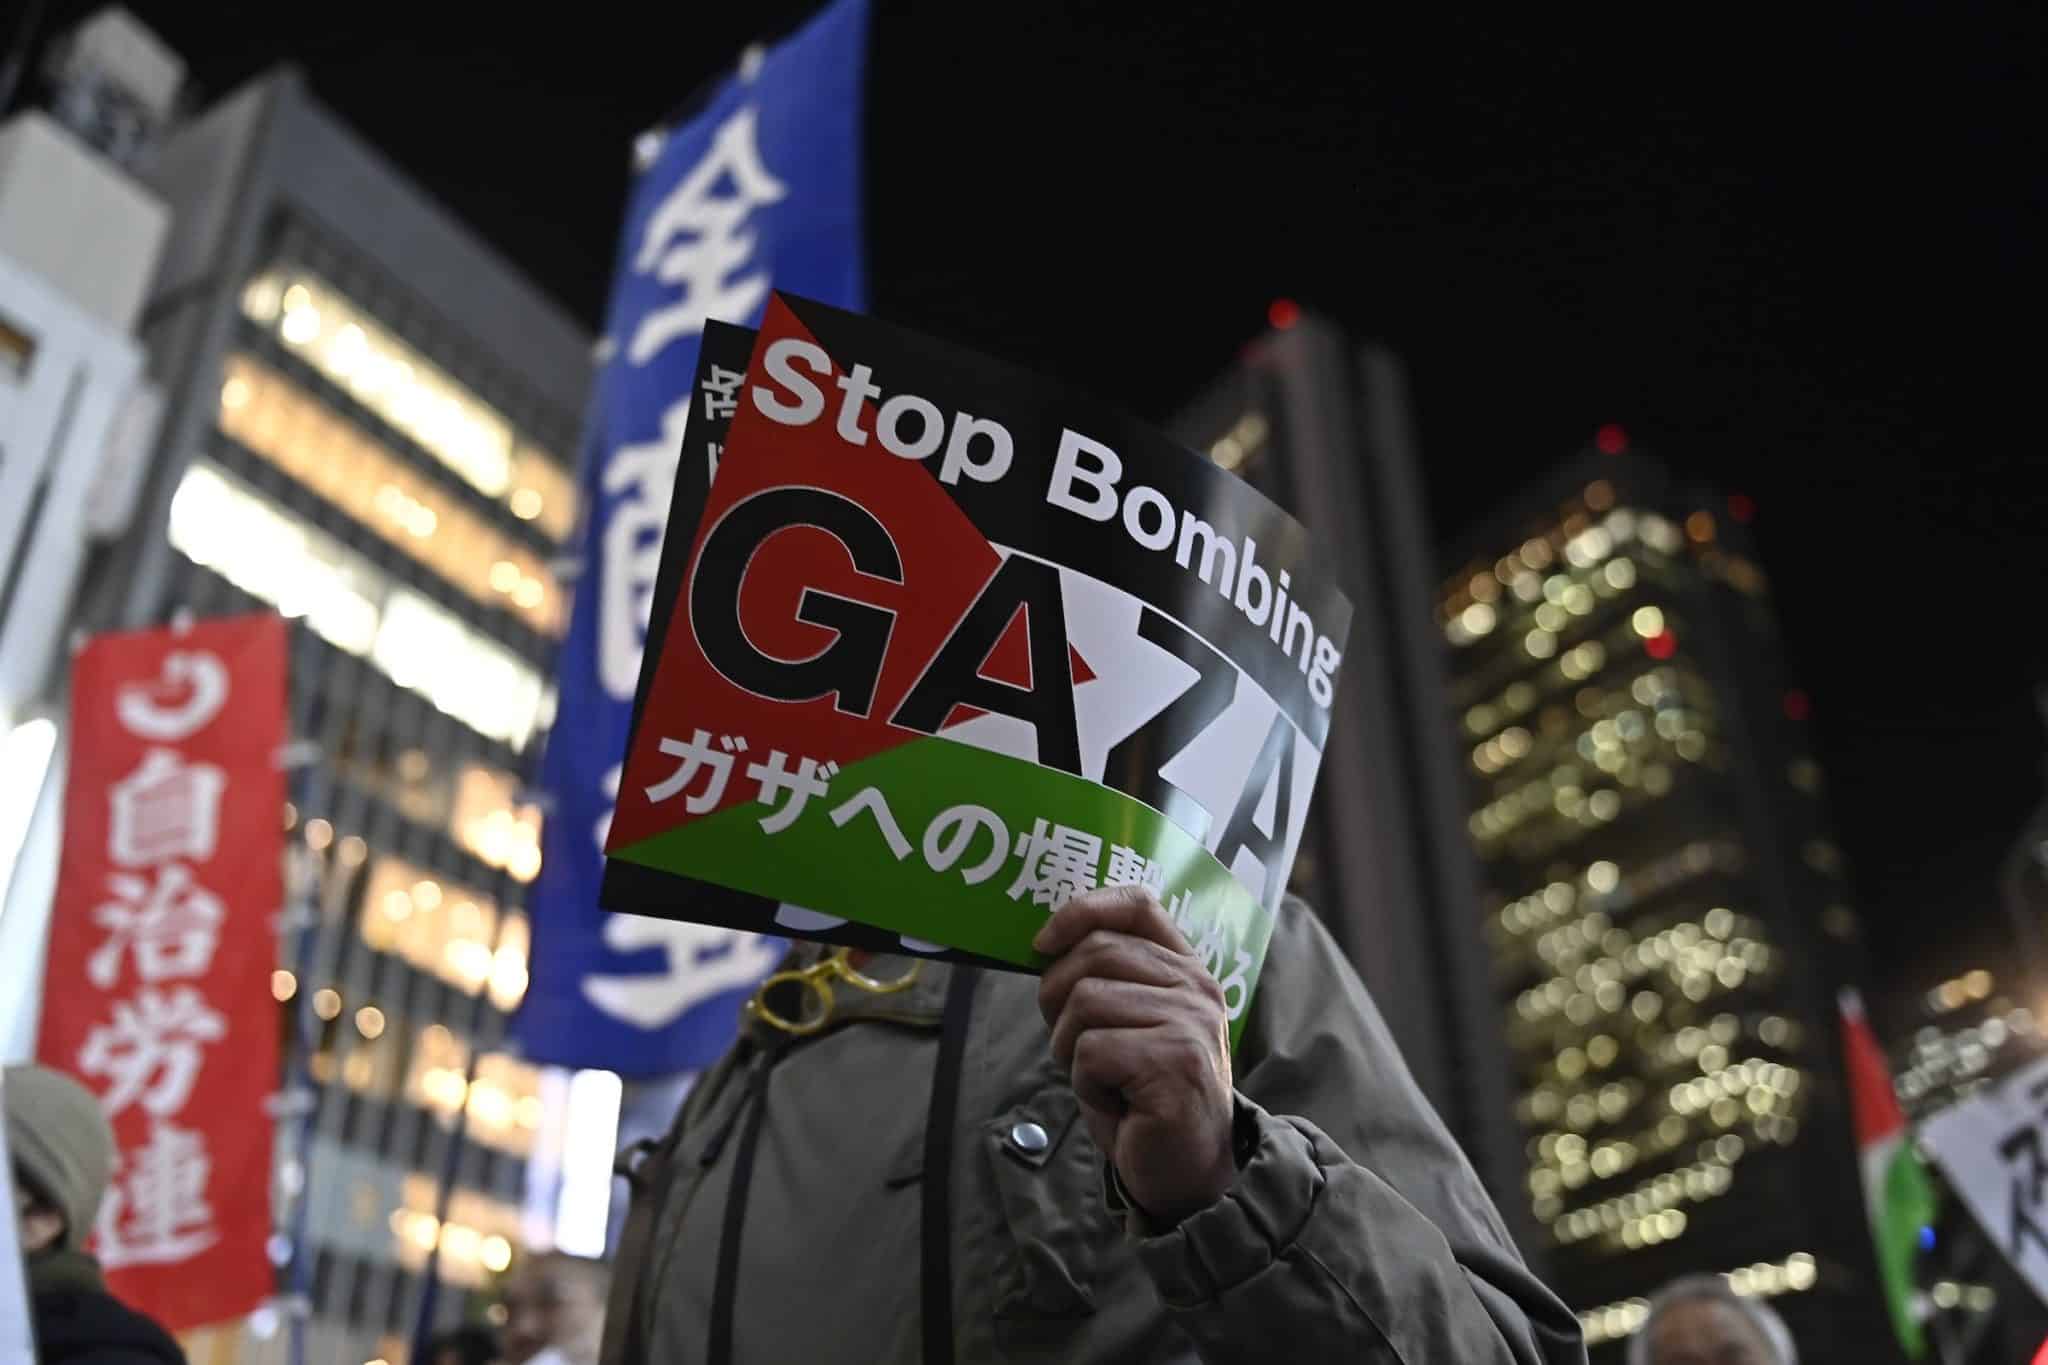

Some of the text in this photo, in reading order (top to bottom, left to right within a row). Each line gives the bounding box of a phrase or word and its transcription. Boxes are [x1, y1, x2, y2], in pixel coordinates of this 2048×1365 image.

[688, 485, 1296, 912] GAZA
[752, 338, 1341, 709] Stop Bombing
